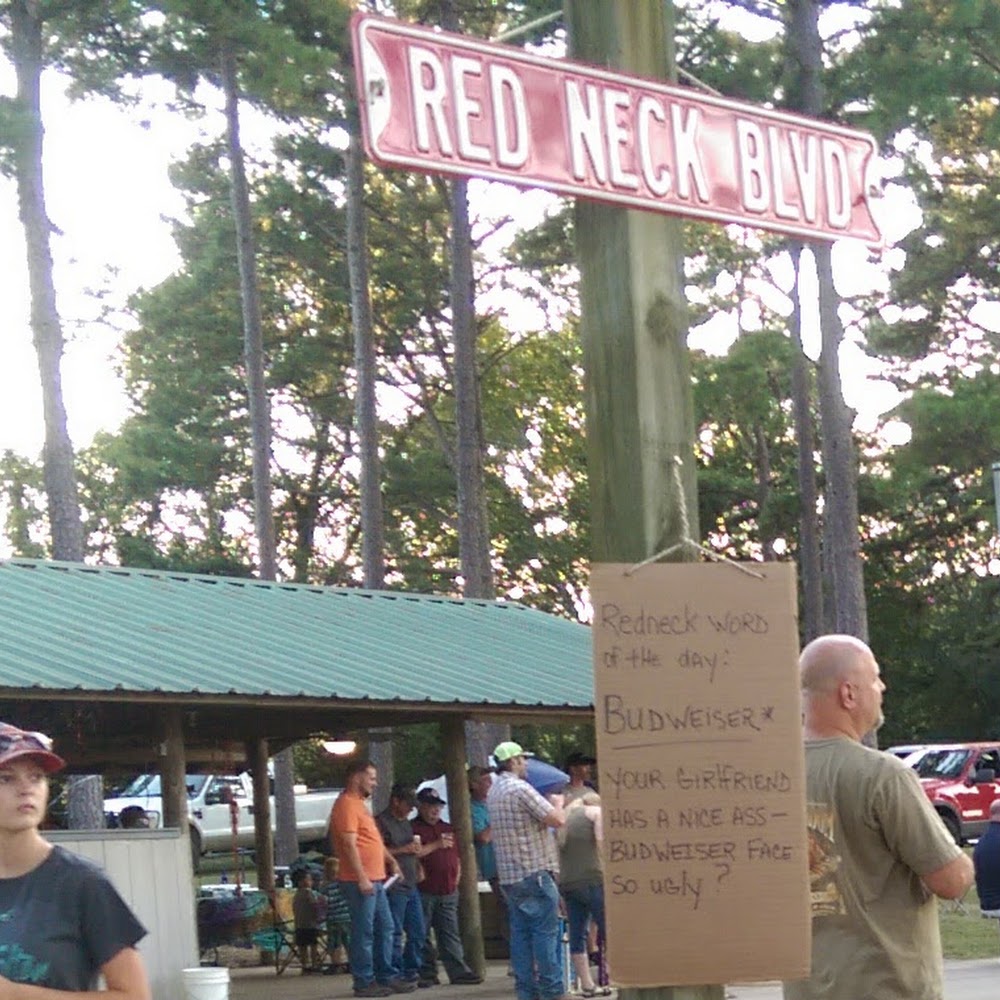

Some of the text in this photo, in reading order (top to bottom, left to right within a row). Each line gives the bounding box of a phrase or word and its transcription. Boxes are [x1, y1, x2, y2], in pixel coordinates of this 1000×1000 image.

[408, 46, 852, 229] RED NECK BLVD
[601, 603, 697, 637] Redneck
[606, 763, 792, 800] YOUR GIRLFRIEND
[609, 808, 648, 829] HAS
[657, 809, 670, 828] A
[679, 808, 722, 829] NICE
[610, 838, 793, 862] BUDWEISER FACE
